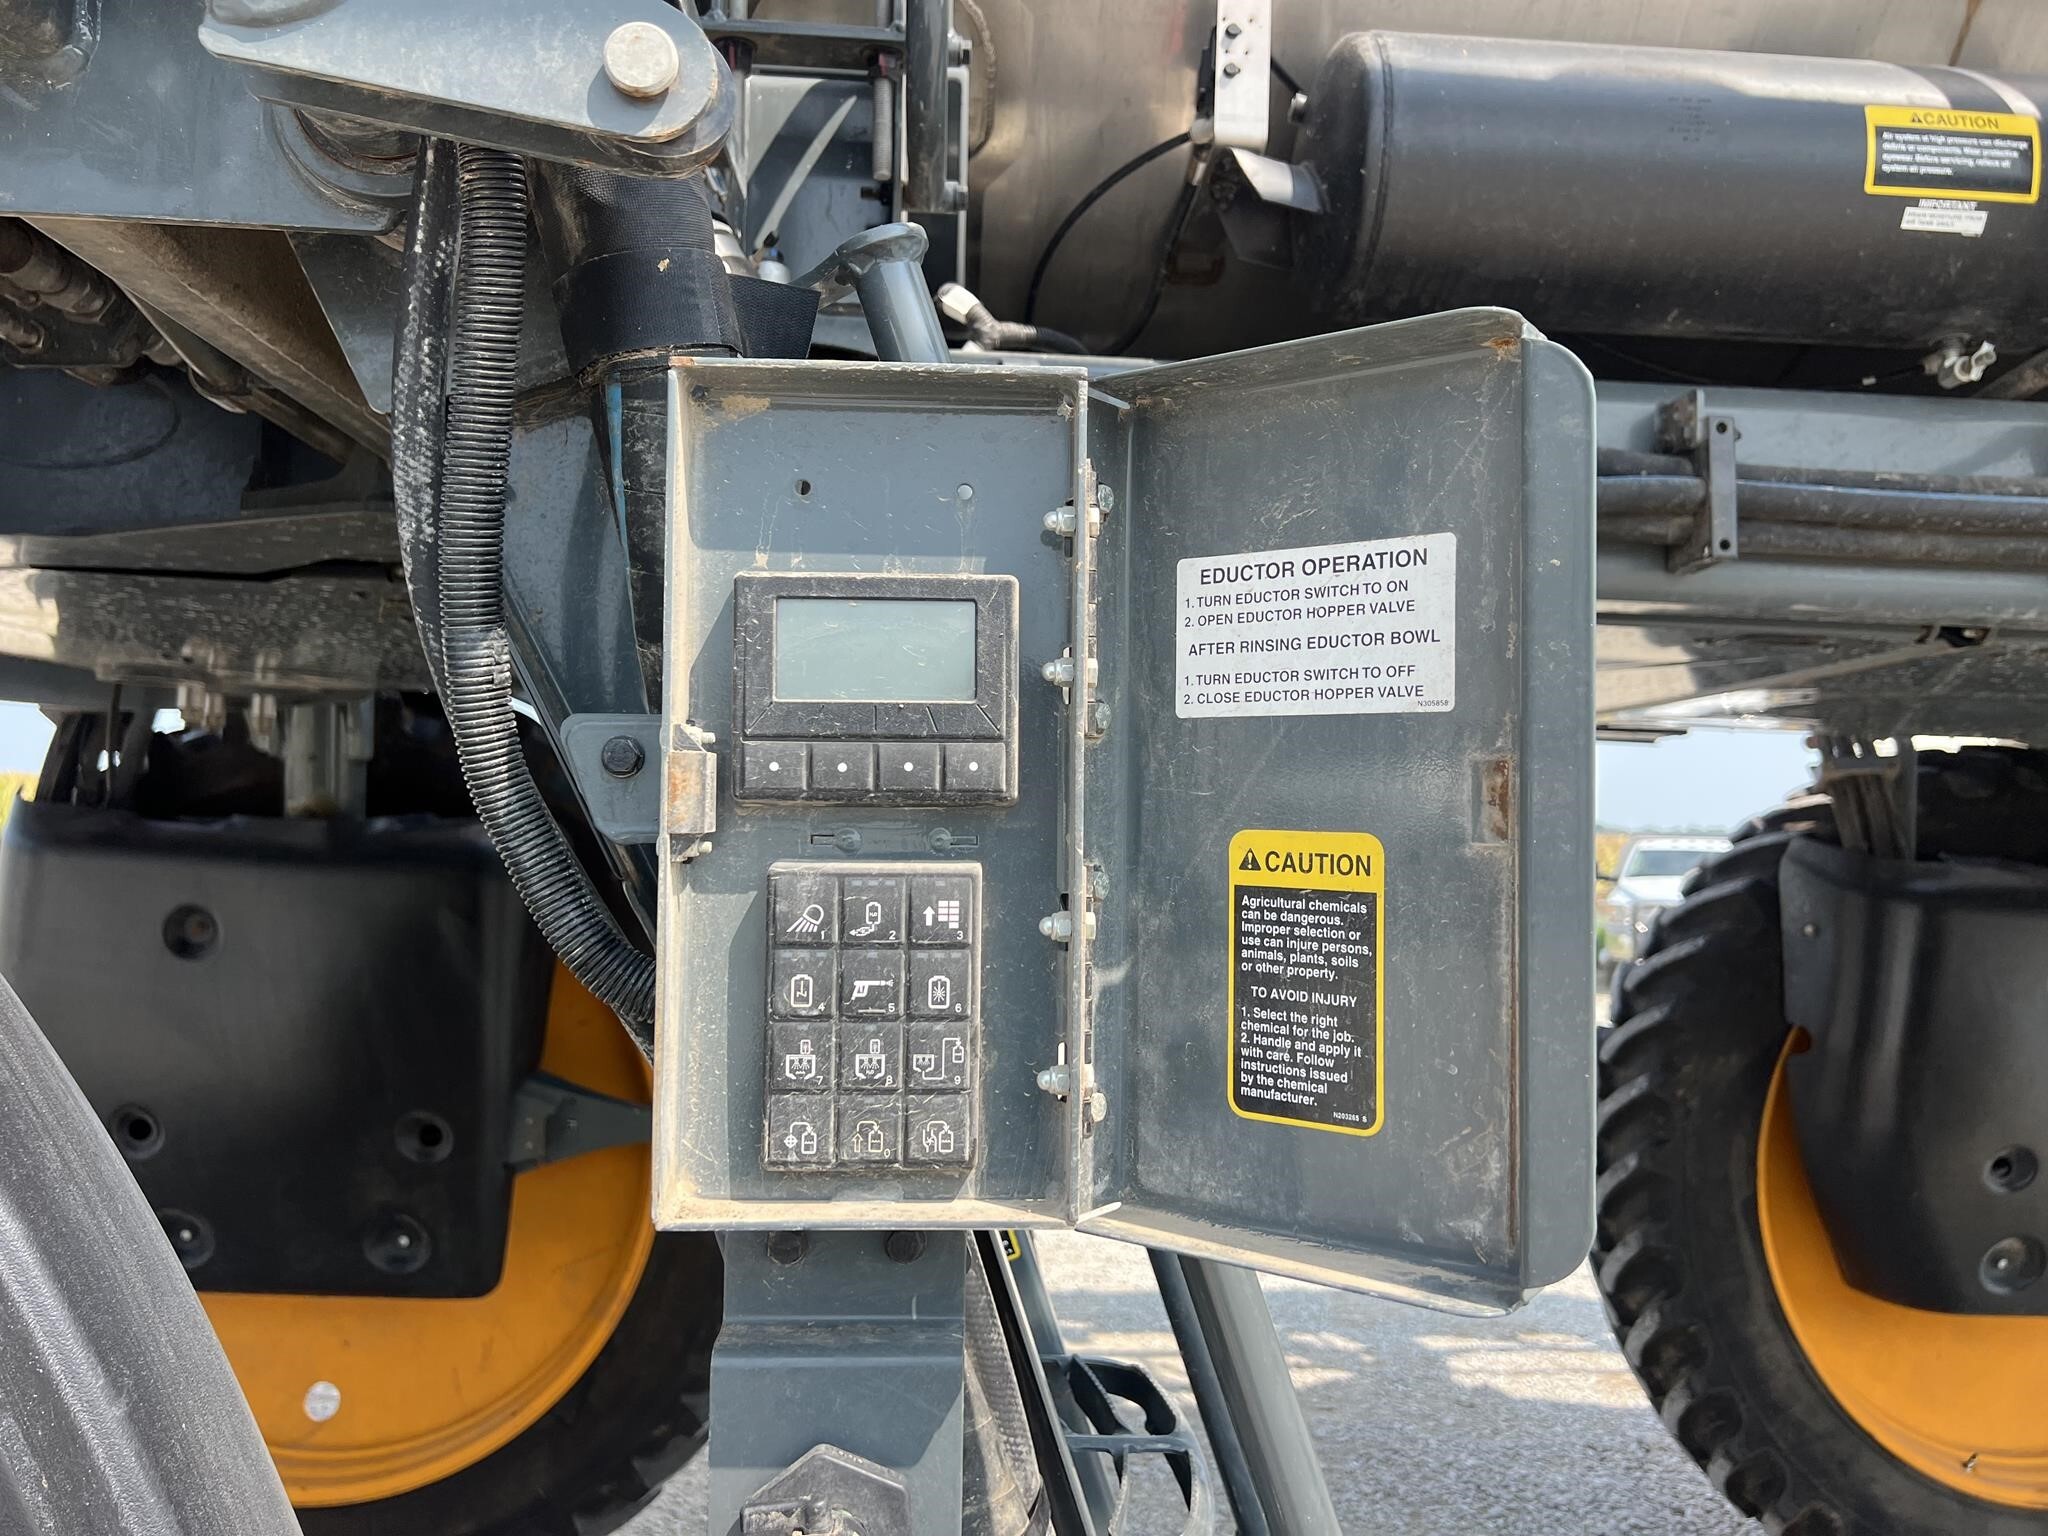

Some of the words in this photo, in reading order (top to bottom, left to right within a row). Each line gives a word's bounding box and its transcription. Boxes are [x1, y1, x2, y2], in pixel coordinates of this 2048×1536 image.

[1922, 112, 1999, 129] CAUTION
[1200, 561, 1294, 584] EDUCTOR
[1302, 548, 1428, 576] OPERATION
[1186, 598, 1194, 608] 1.
[1197, 595, 1231, 608] TURN
[1236, 590, 1300, 604] EDUCTOR
[1305, 584, 1361, 600] SWITCH
[1362, 582, 1382, 596] TO
[1386, 580, 1408, 593] ON
[1185, 618, 1194, 628] 2.
[1198, 614, 1233, 627] OPEN
[1238, 608, 1302, 624] EDUCTOR
[1306, 604, 1366, 619] HOPPER
[1370, 600, 1415, 614] VALVE
[1189, 641, 1235, 656] AFTER
[1240, 637, 1302, 653] RINSING
[1307, 632, 1384, 649] EDUCTOR
[1390, 629, 1440, 644] BOWL
[1184, 676, 1194, 686] 1.
[1196, 674, 1230, 686] TURN
[1235, 670, 1299, 684] EDUCTOR
[1304, 668, 1360, 681] SWITCH
[1362, 666, 1381, 679] TO
[1386, 665, 1416, 678] OFF
[1184, 695, 1194, 704] 2.
[1197, 692, 1240, 704] CLOSE
[1245, 690, 1309, 702] EDUCTOR
[1314, 687, 1374, 700] HOPPER
[1378, 685, 1424, 698] VALVE
[1265, 851, 1371, 876] CAUTION
[1242, 895, 1305, 910] Agricultural
[1309, 900, 1367, 914] chemicals
[1242, 911, 1260, 920] can
[1264, 910, 1277, 921] be
[1280, 911, 1344, 925] dangerous.
[889, 931, 896, 940] 2
[956, 931, 964, 940] 3
[1242, 922, 1291, 935] Improper
[1294, 925, 1345, 939] selection
[1348, 930, 1361, 940] or
[1242, 937, 1261, 946] use
[1264, 939, 1283, 947] can
[1287, 938, 1319, 951] injure
[1322, 944, 1372, 956] persons,
[1241, 949, 1287, 963] animals,
[1290, 952, 1328, 966] plants,
[1331, 956, 1358, 968] soils
[1241, 963, 1253, 971] or
[1255, 962, 1284, 974] other
[1287, 966, 1338, 981] property.
[1251, 986, 1267, 998] TO
[1270, 989, 1308, 1002] AVOID
[1312, 992, 1357, 1007] INJURY
[818, 1002, 825, 1012] 4
[888, 1003, 895, 1012] 5
[955, 1003, 962, 1012] 6
[1241, 1007, 1250, 1017] 1.
[1253, 1008, 1287, 1021] Select
[1290, 1012, 1308, 1023] the
[1311, 1014, 1338, 1028] right
[1241, 1020, 1289, 1034] chemical
[1293, 1025, 1308, 1036] for
[1312, 1027, 1329, 1039] the
[1333, 1030, 1354, 1043] job.
[1241, 1033, 1250, 1043] 2.
[1253, 1034, 1291, 1048] Handle
[1295, 1040, 1316, 1051] and
[1319, 1042, 1350, 1058] apply
[1354, 1046, 1361, 1057] it
[1241, 1047, 1263, 1058] with
[1266, 1051, 1293, 1062] care.
[1297, 1053, 1334, 1067] Follow
[817, 1076, 824, 1085] 7
[886, 1076, 893, 1085] 8
[954, 1076, 961, 1085] 9
[1241, 1059, 1306, 1077] instructions
[1310, 1068, 1348, 1083] issued
[1241, 1072, 1254, 1084] by
[1257, 1074, 1274, 1086] the
[1277, 1078, 1327, 1094] chemical
[1241, 1088, 1317, 1106] manufacturer.
